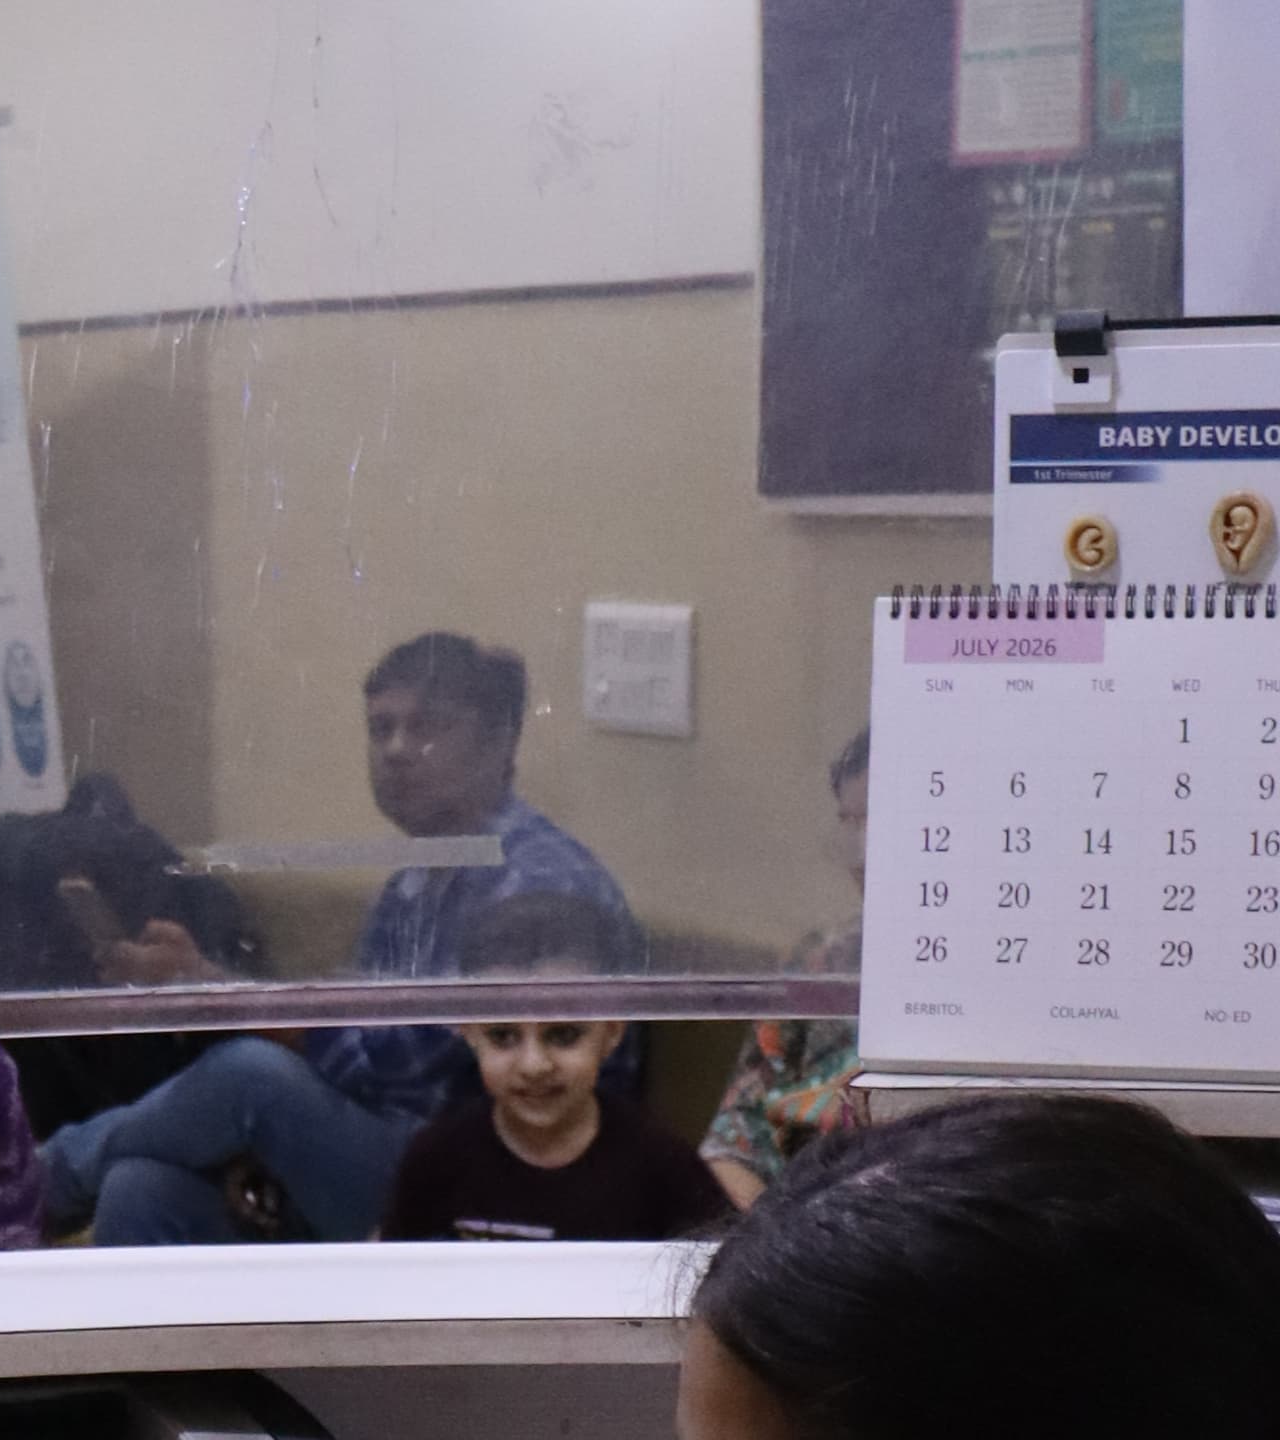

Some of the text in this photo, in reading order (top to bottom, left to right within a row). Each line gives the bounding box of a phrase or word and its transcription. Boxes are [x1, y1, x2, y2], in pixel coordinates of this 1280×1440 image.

[1099, 426, 1171, 448] BABY
[1055, 468, 1112, 481] Trimester
[951, 637, 1057, 657] JULY 2026
[926, 679, 953, 692] SUN
[1006, 679, 1034, 692] MON
[1091, 679, 1115, 693] TUE
[1172, 679, 1201, 693] WED
[1179, 716, 1278, 745] 1 2
[928, 770, 1276, 801] 5 6 7 8 9
[921, 825, 1280, 857] 12 13 14 15 16
[919, 880, 1279, 914] 19 20 21 22 23
[915, 935, 1278, 970] 26 27 28 29 30
